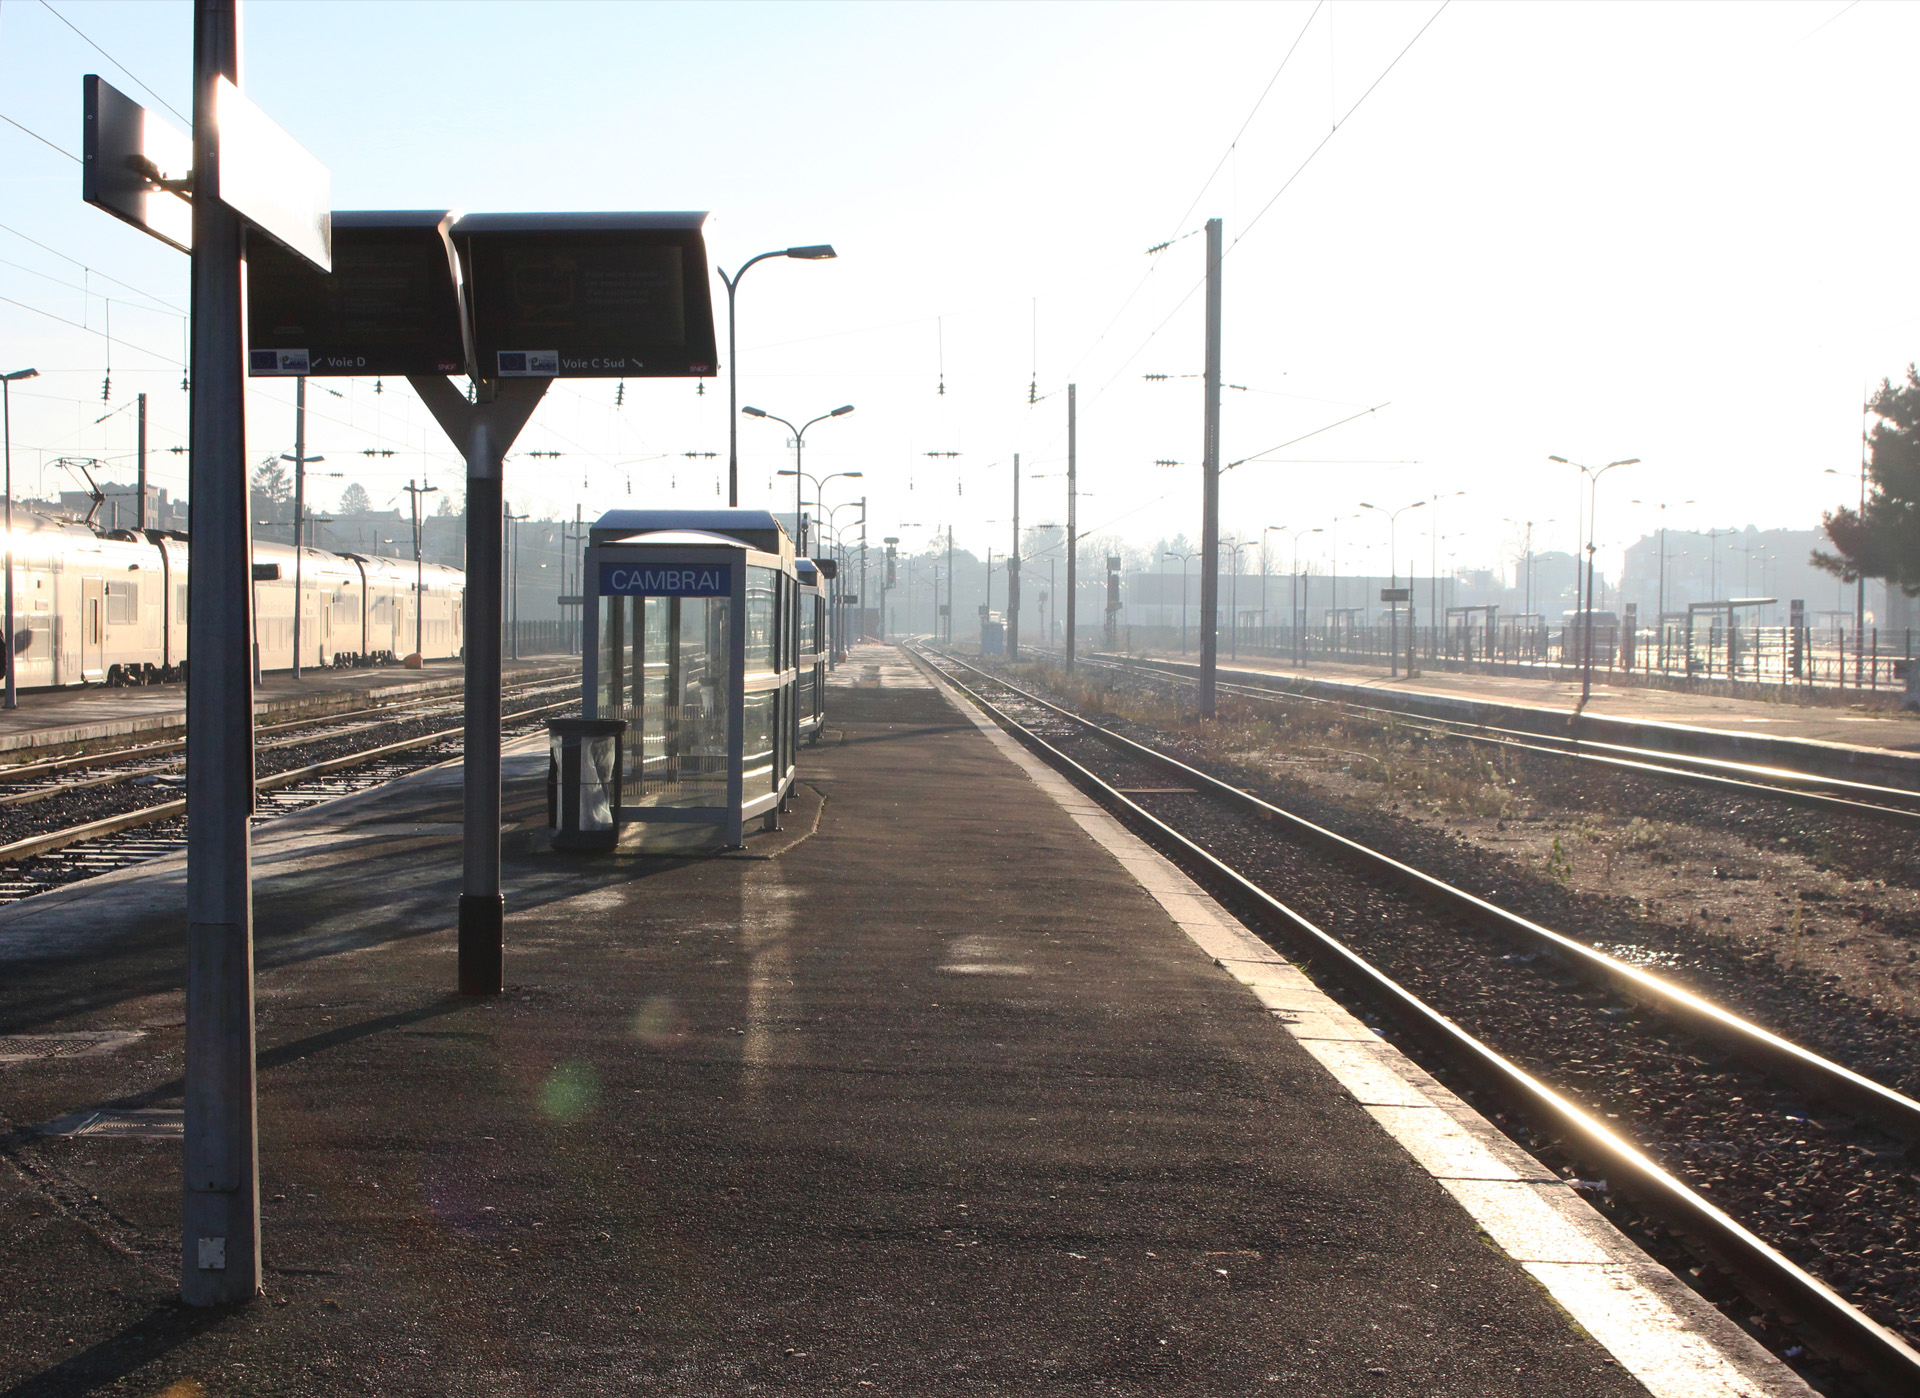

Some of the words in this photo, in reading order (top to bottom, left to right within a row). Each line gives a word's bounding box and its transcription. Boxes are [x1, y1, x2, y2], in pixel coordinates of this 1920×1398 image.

[327, 357, 353, 367] Voie
[357, 357, 366, 367] D
[562, 358, 588, 368] Voie
[591, 358, 600, 368] C
[603, 358, 625, 368] Sud
[611, 570, 719, 590] CAMBRAI
